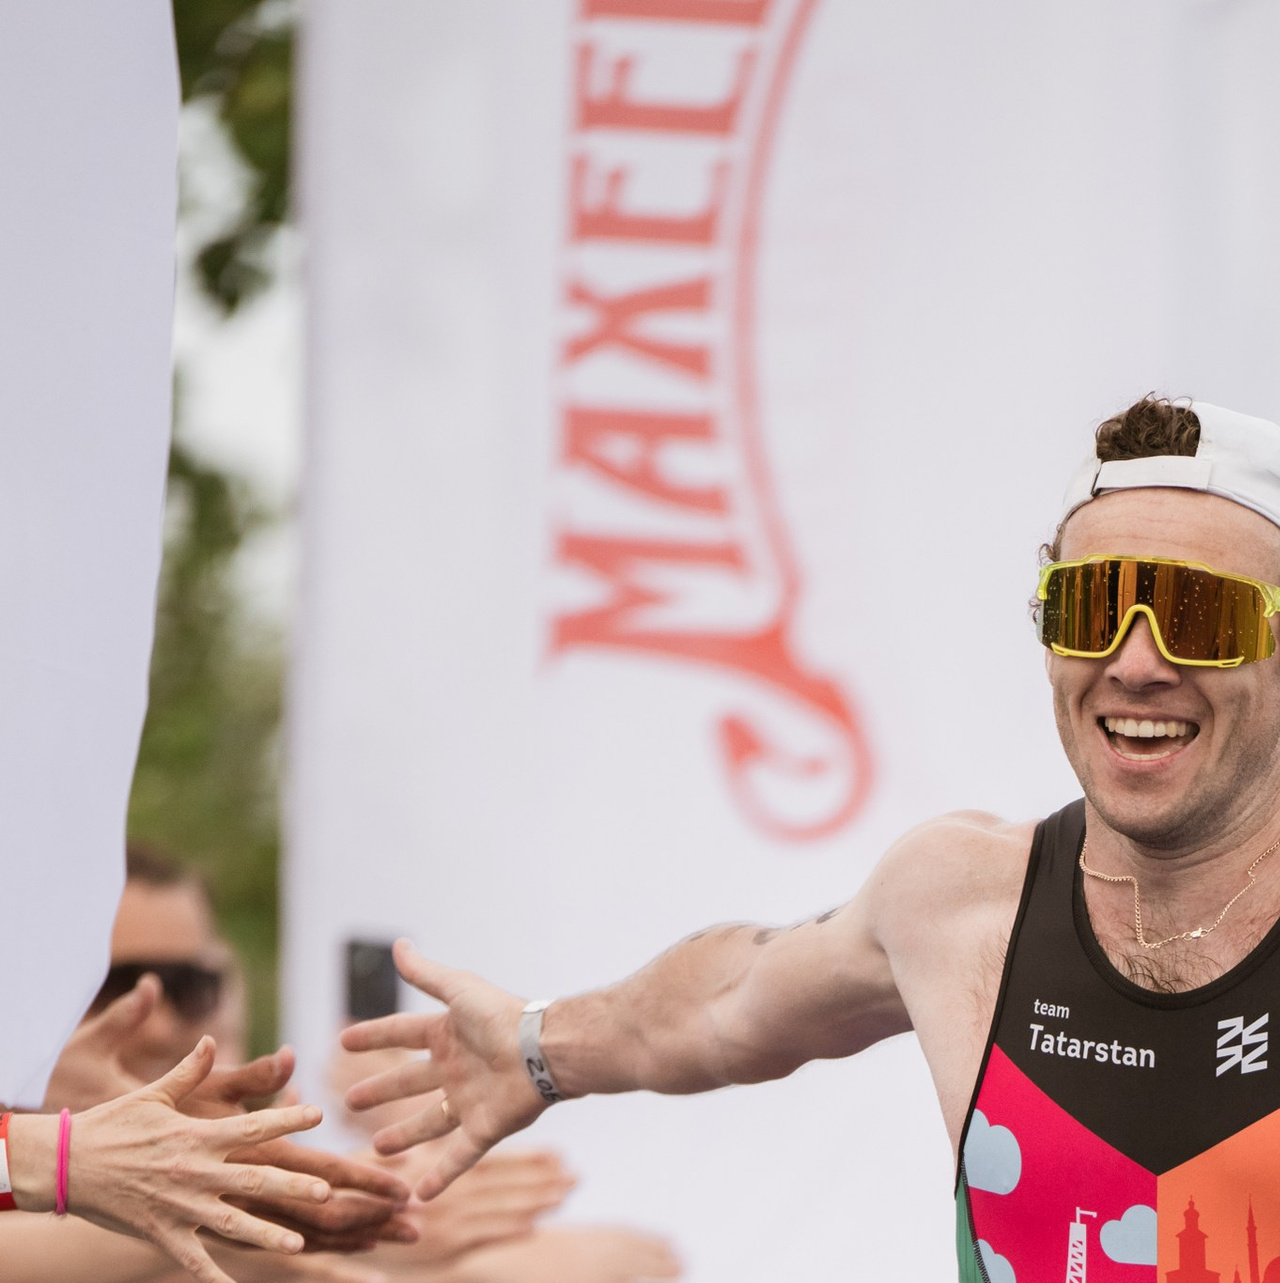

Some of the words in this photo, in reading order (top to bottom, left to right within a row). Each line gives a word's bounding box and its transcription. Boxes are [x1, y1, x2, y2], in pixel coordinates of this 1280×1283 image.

[538, 0, 800, 690] МАХЕЕ
[1033, 998, 1070, 1019] team
[1029, 1023, 1156, 1068] Tatarstan
